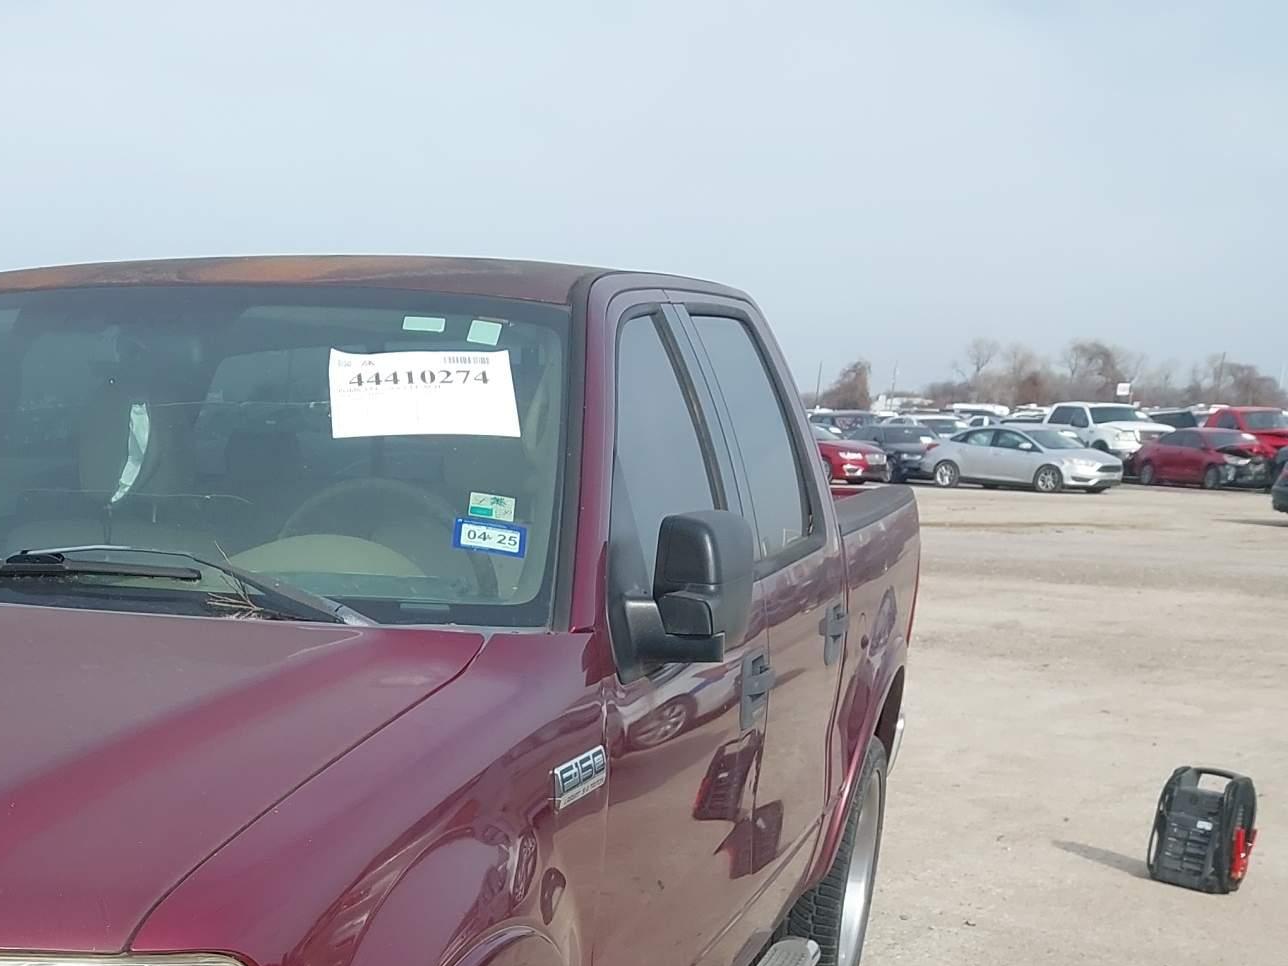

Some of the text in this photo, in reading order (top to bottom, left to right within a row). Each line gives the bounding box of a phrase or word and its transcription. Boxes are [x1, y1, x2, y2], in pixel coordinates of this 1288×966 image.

[349, 369, 490, 386] 44410274
[467, 529, 518, 547] 04 25
